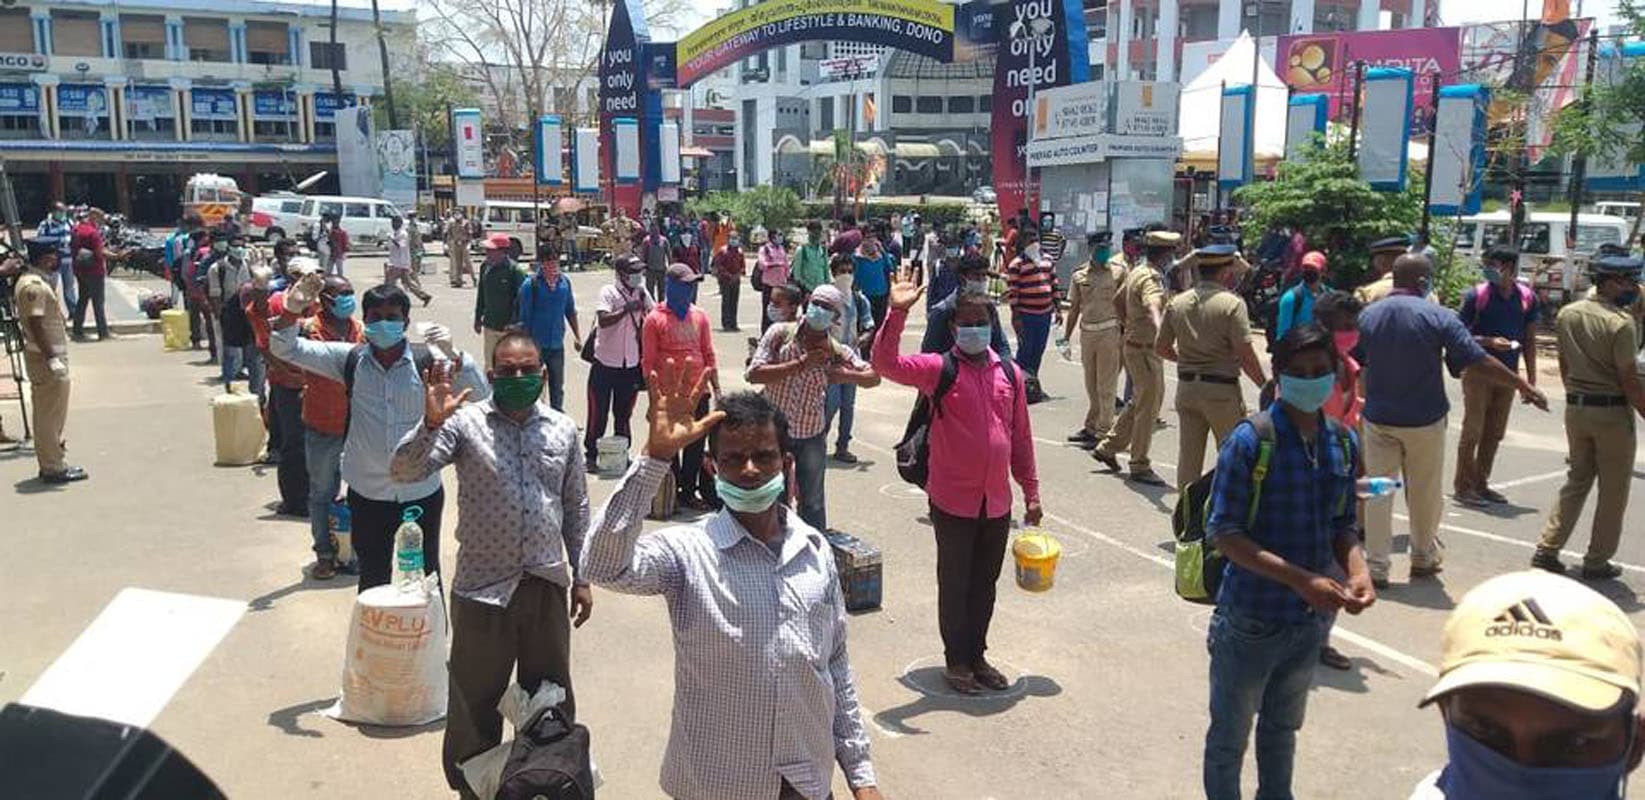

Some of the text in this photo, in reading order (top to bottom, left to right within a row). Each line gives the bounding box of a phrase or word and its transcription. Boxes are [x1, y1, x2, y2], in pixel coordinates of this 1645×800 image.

[1015, 0, 1052, 22] you
[688, 48, 716, 71] YOUR
[716, 28, 760, 56] GATEWAY
[762, 23, 776, 37] TO
[778, 13, 833, 33] LIFESTYLE
[838, 14, 846, 26] &
[848, 13, 904, 34] BANKING,
[906, 21, 944, 44] DONO
[608, 48, 632, 68] you
[607, 70, 634, 90] only
[1006, 59, 1057, 87] need
[606, 90, 637, 112] need
[1484, 620, 1564, 642] adidas
